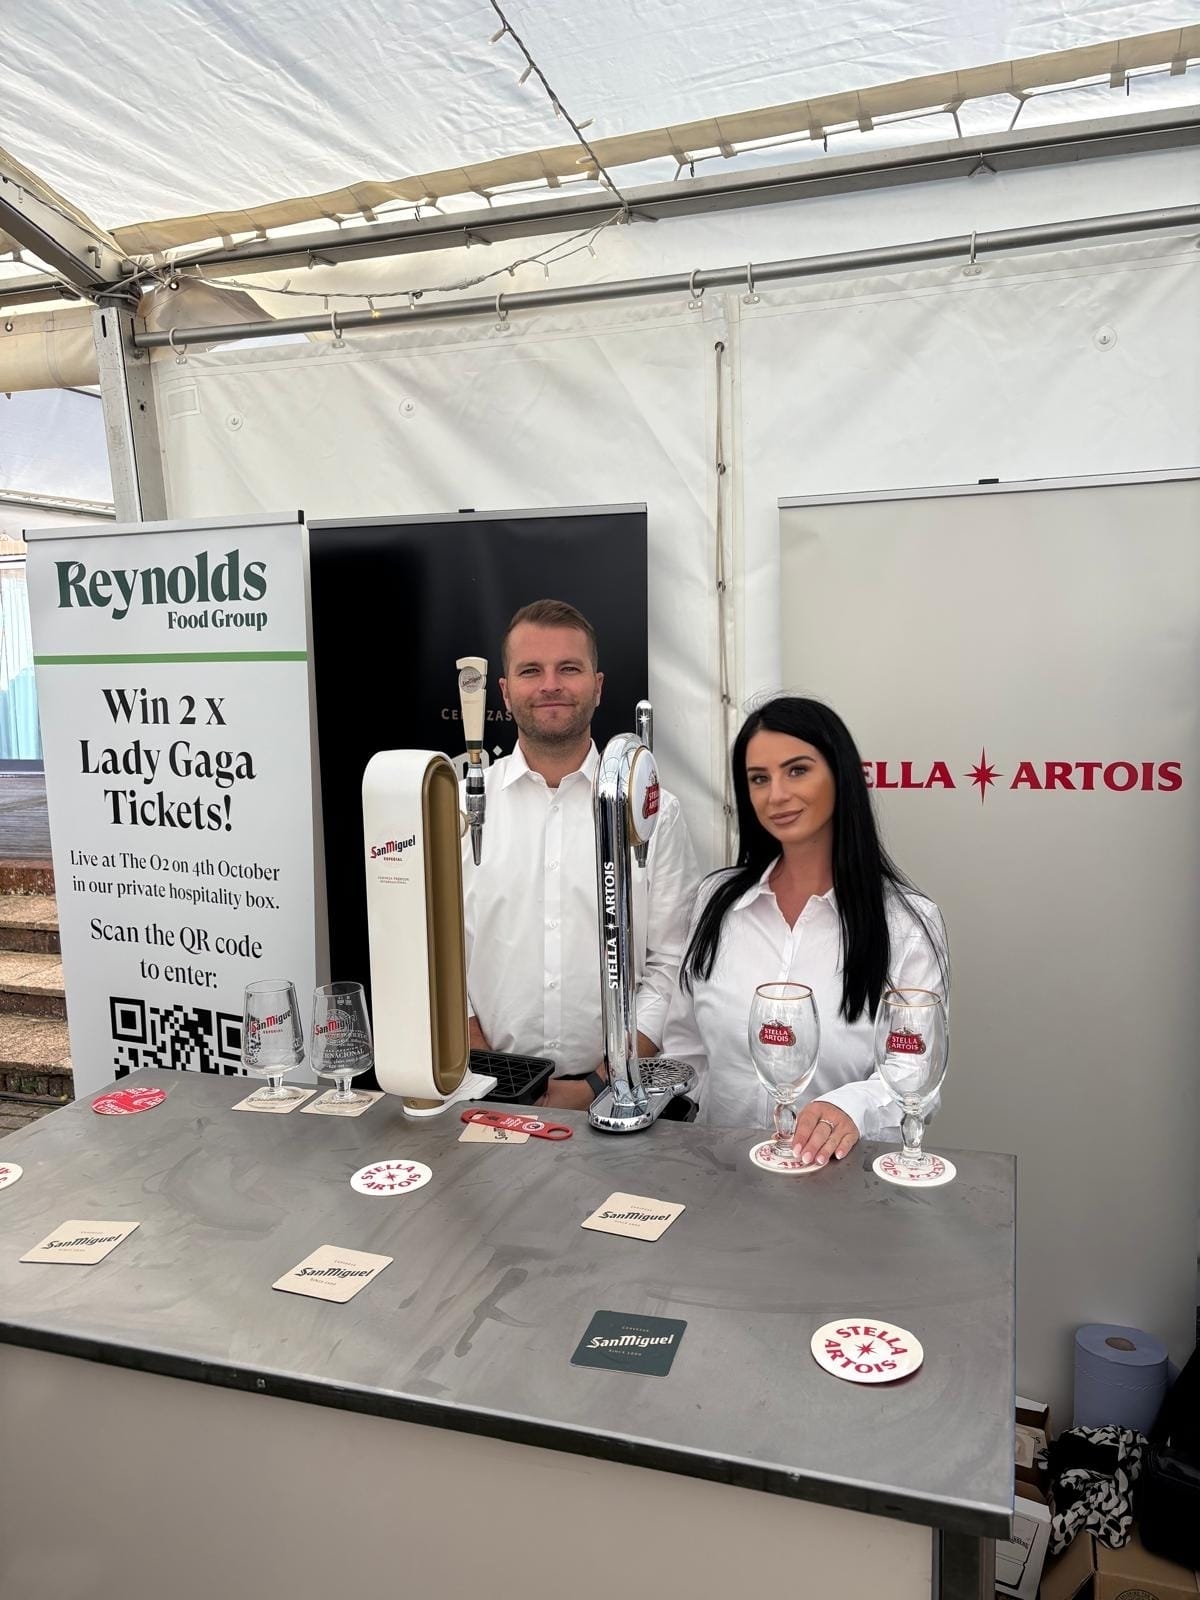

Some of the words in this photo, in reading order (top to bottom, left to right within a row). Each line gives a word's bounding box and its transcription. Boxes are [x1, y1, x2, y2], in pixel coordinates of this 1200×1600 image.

[54, 549, 267, 620] Reynolds
[167, 610, 209, 630] Food
[212, 610, 268, 631] Group
[101, 687, 170, 725] Win
[180, 695, 196, 725] 2
[79, 740, 161, 785] Lady
[168, 740, 257, 789] Gaga
[1010, 761, 1184, 791] ARTOIS
[103, 789, 233, 832] Tickets!
[370, 834, 416, 859] SanMiguel
[70, 850, 98, 867] Live
[102, 854, 116, 868] at
[119, 852, 147, 869] The
[150, 854, 170, 871] O2
[172, 859, 189, 873] on
[192, 859, 214, 877] 4th
[218, 860, 280, 881] October
[73, 876, 86, 892] in
[89, 880, 113, 894] our
[117, 880, 166, 898] private
[169, 883, 242, 910] hospitality
[246, 891, 280, 909] box.
[604, 861, 616, 916] ARTOIS
[90, 918, 139, 943] Scan
[145, 923, 175, 947] the
[180, 926, 211, 955] QR
[215, 935, 262, 958] code
[140, 958, 159, 979] to
[164, 965, 217, 988] enter:
[608, 937, 619, 990] STELLA
[764, 1028, 788, 1036] STELLA
[764, 1034, 789, 1042] ARTOIS
[891, 1036, 918, 1045] STELLA
[361, 1164, 415, 1180] STELLA
[363, 1173, 422, 1190] ARTOIS
[598, 1211, 671, 1221] SanMiguel
[40, 1234, 123, 1250] SanMiguel
[294, 1268, 375, 1278] SanMiguel
[585, 1334, 675, 1348] SanMiguel
[836, 1326, 908, 1355] STELLA
[825, 1339, 897, 1373] ARTOIS
